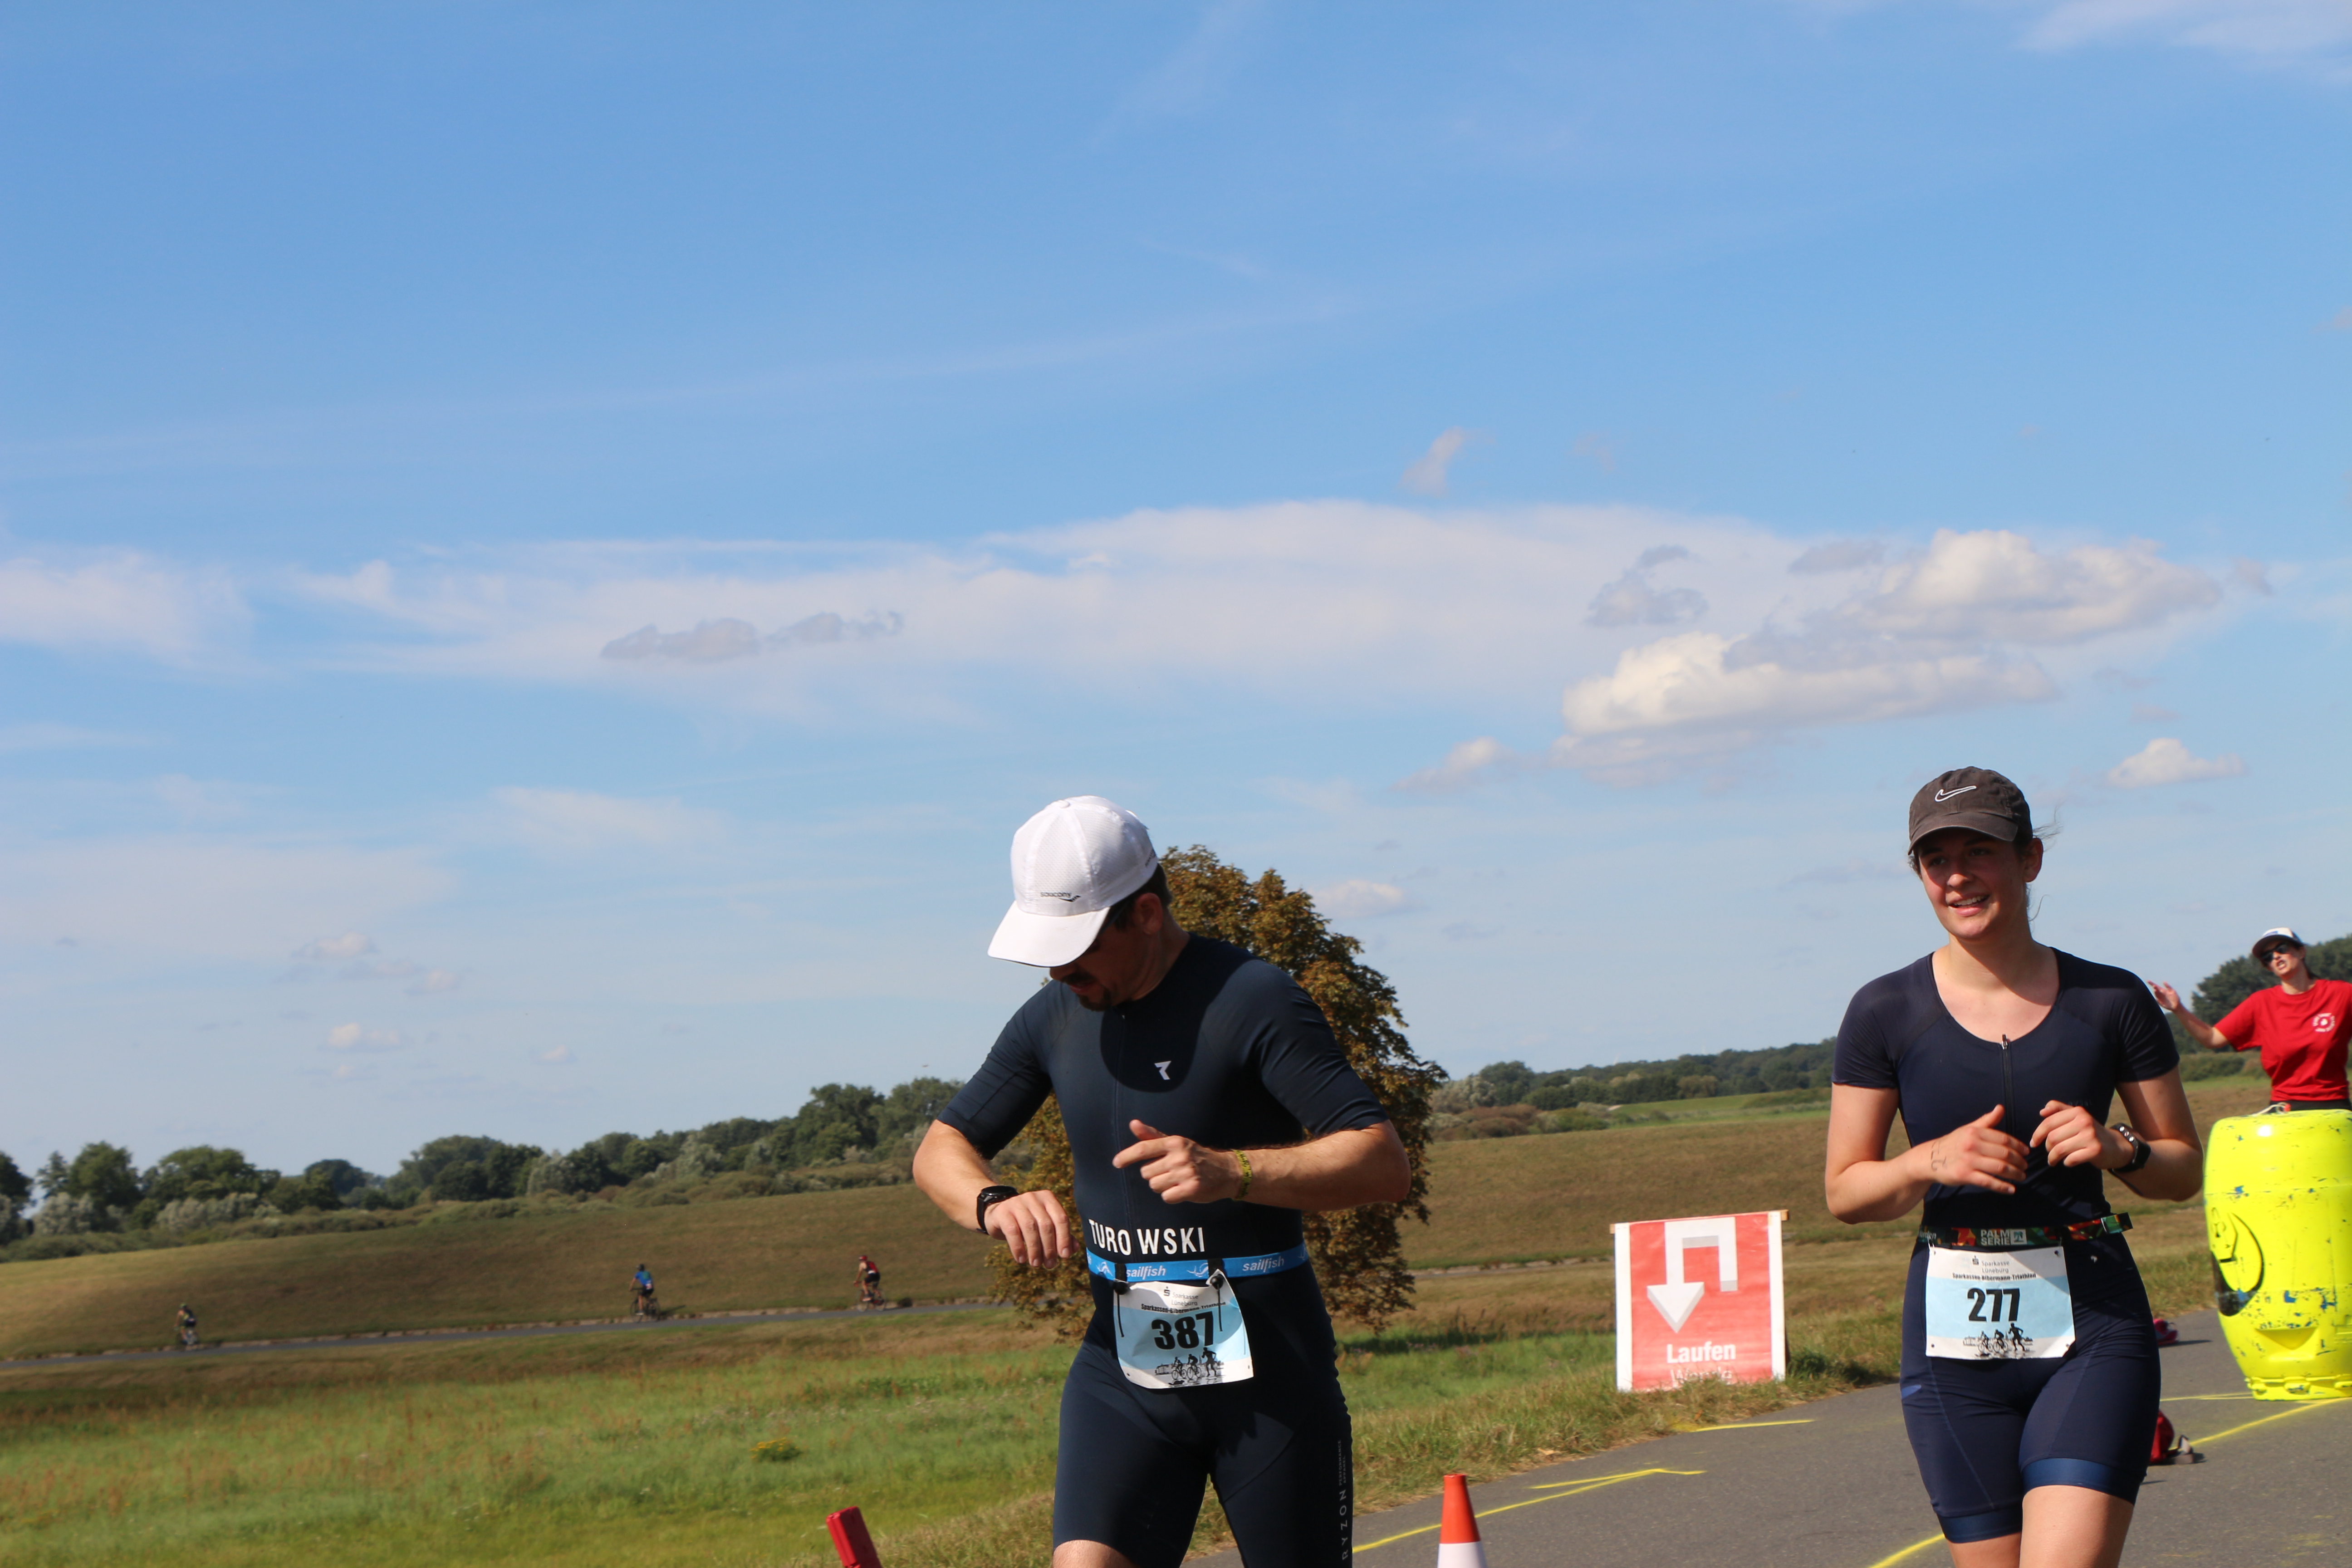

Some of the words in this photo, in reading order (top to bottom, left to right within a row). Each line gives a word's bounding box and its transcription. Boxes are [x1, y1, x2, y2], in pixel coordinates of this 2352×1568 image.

[1981, 1237, 2010, 1245] SERIE
[1126, 1265, 1166, 1280] sailfish
[1242, 1256, 1284, 1273] sailfish
[1967, 1288, 2020, 1322] 277
[1151, 1311, 1214, 1350] 387
[1666, 1341, 1736, 1363] Laufen
[1339, 1490, 1348, 1560] RYZON
